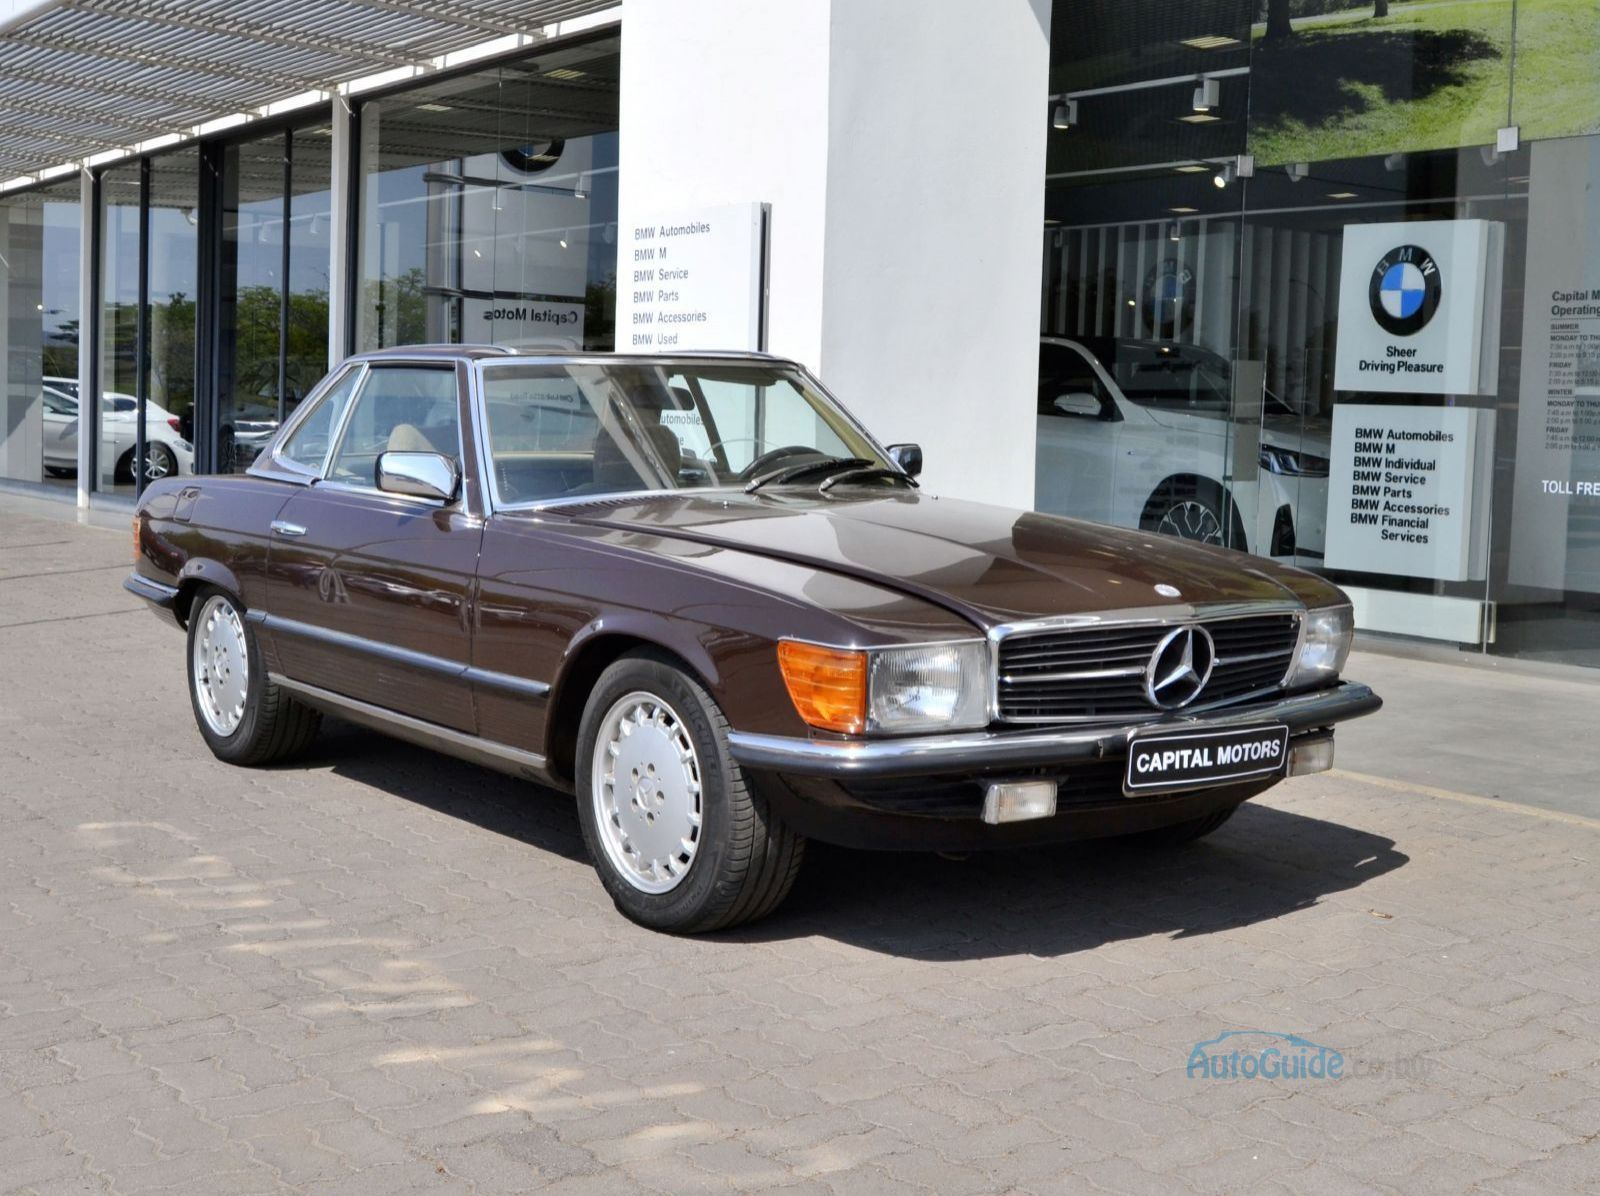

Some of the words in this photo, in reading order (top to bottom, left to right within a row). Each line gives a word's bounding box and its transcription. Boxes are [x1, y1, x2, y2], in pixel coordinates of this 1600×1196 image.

[635, 226, 655, 240] BMW
[659, 222, 710, 238] Automobiles
[634, 248, 655, 261] BMW
[659, 247, 667, 259] M
[1376, 247, 1436, 277] BMW
[633, 269, 654, 282] BMW
[658, 267, 689, 281] Service
[633, 291, 654, 303] BMW
[658, 289, 679, 302] Parts
[1552, 289, 1589, 303] Capital
[632, 312, 654, 324] BMW
[658, 310, 707, 323] Accessories
[1551, 304, 1600, 317] Operating
[632, 333, 653, 345] BMW
[657, 333, 678, 344] Used
[1386, 346, 1417, 357] Sheer
[1359, 360, 1395, 374] Driving
[1397, 361, 1444, 373] Pleasure
[661, 413, 704, 426] utomobile
[1355, 428, 1383, 440] BMW
[1387, 429, 1454, 442] Automobiles
[1354, 442, 1382, 454] BMW
[1386, 443, 1395, 454] M
[1353, 456, 1382, 468] BMW
[1385, 458, 1436, 471] Individual
[1353, 470, 1381, 482] BMW
[1385, 472, 1426, 485] Service
[1352, 485, 1380, 496] BMW
[1383, 487, 1412, 499] Parts
[1541, 480, 1573, 494] TOLL
[1576, 481, 1600, 496] FRE
[1351, 499, 1379, 511] BMW
[1383, 500, 1450, 516] Accessories
[1350, 513, 1378, 525] BMW
[1381, 515, 1429, 529] Financial
[1381, 529, 1429, 544] Services
[1136, 748, 1213, 772] CAPITAL
[1217, 739, 1280, 765] MOTORS
